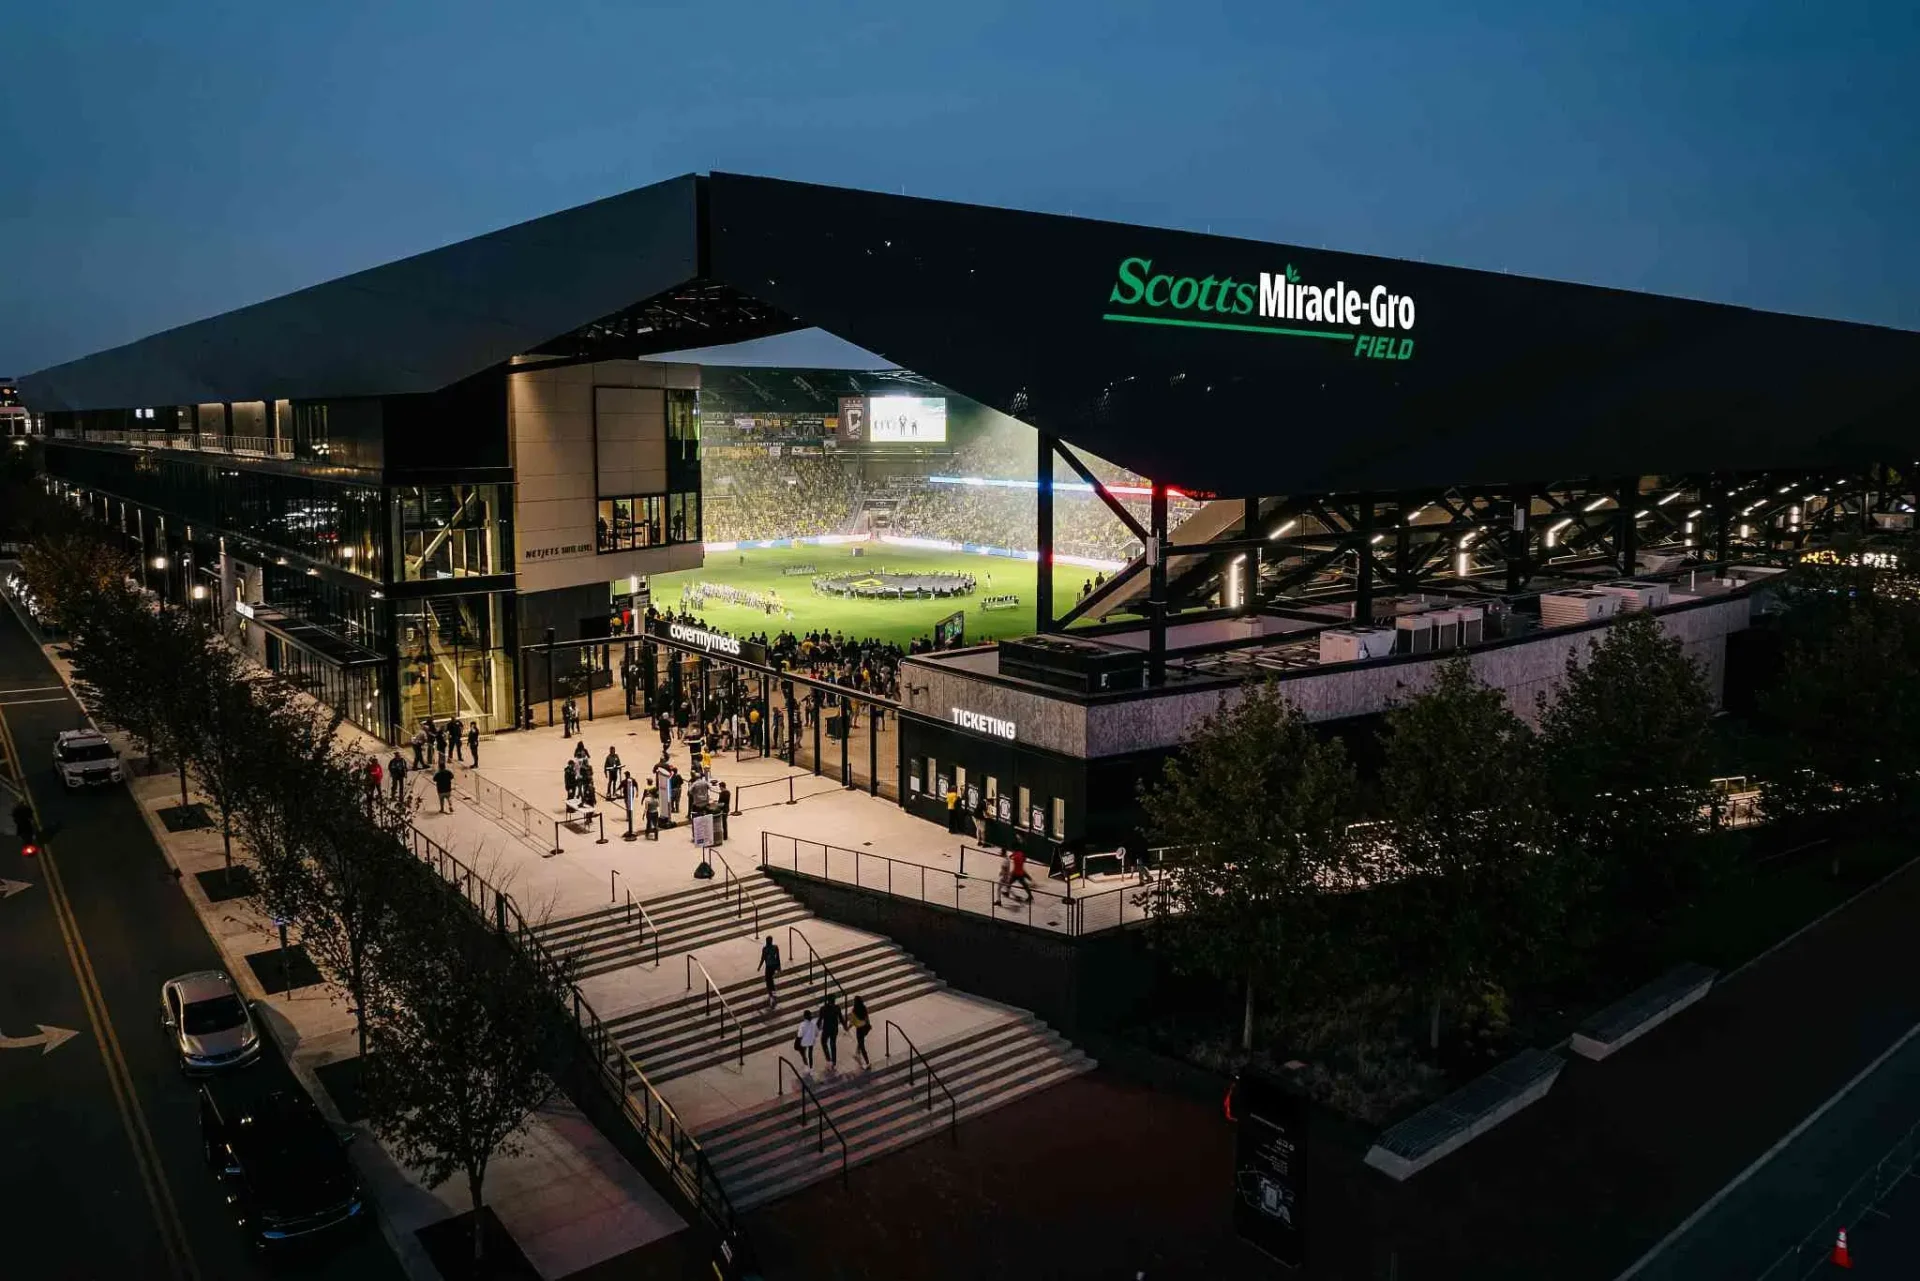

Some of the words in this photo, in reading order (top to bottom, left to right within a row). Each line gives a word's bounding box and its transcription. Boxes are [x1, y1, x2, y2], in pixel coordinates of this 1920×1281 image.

[1110, 257, 1256, 315] Scotts
[1259, 267, 1415, 330] Miracle-Gro
[1354, 335, 1414, 360] FIELD
[525, 547, 559, 558] NETJETS
[670, 624, 740, 654] covermymeds
[952, 707, 1016, 740] TICKETING
